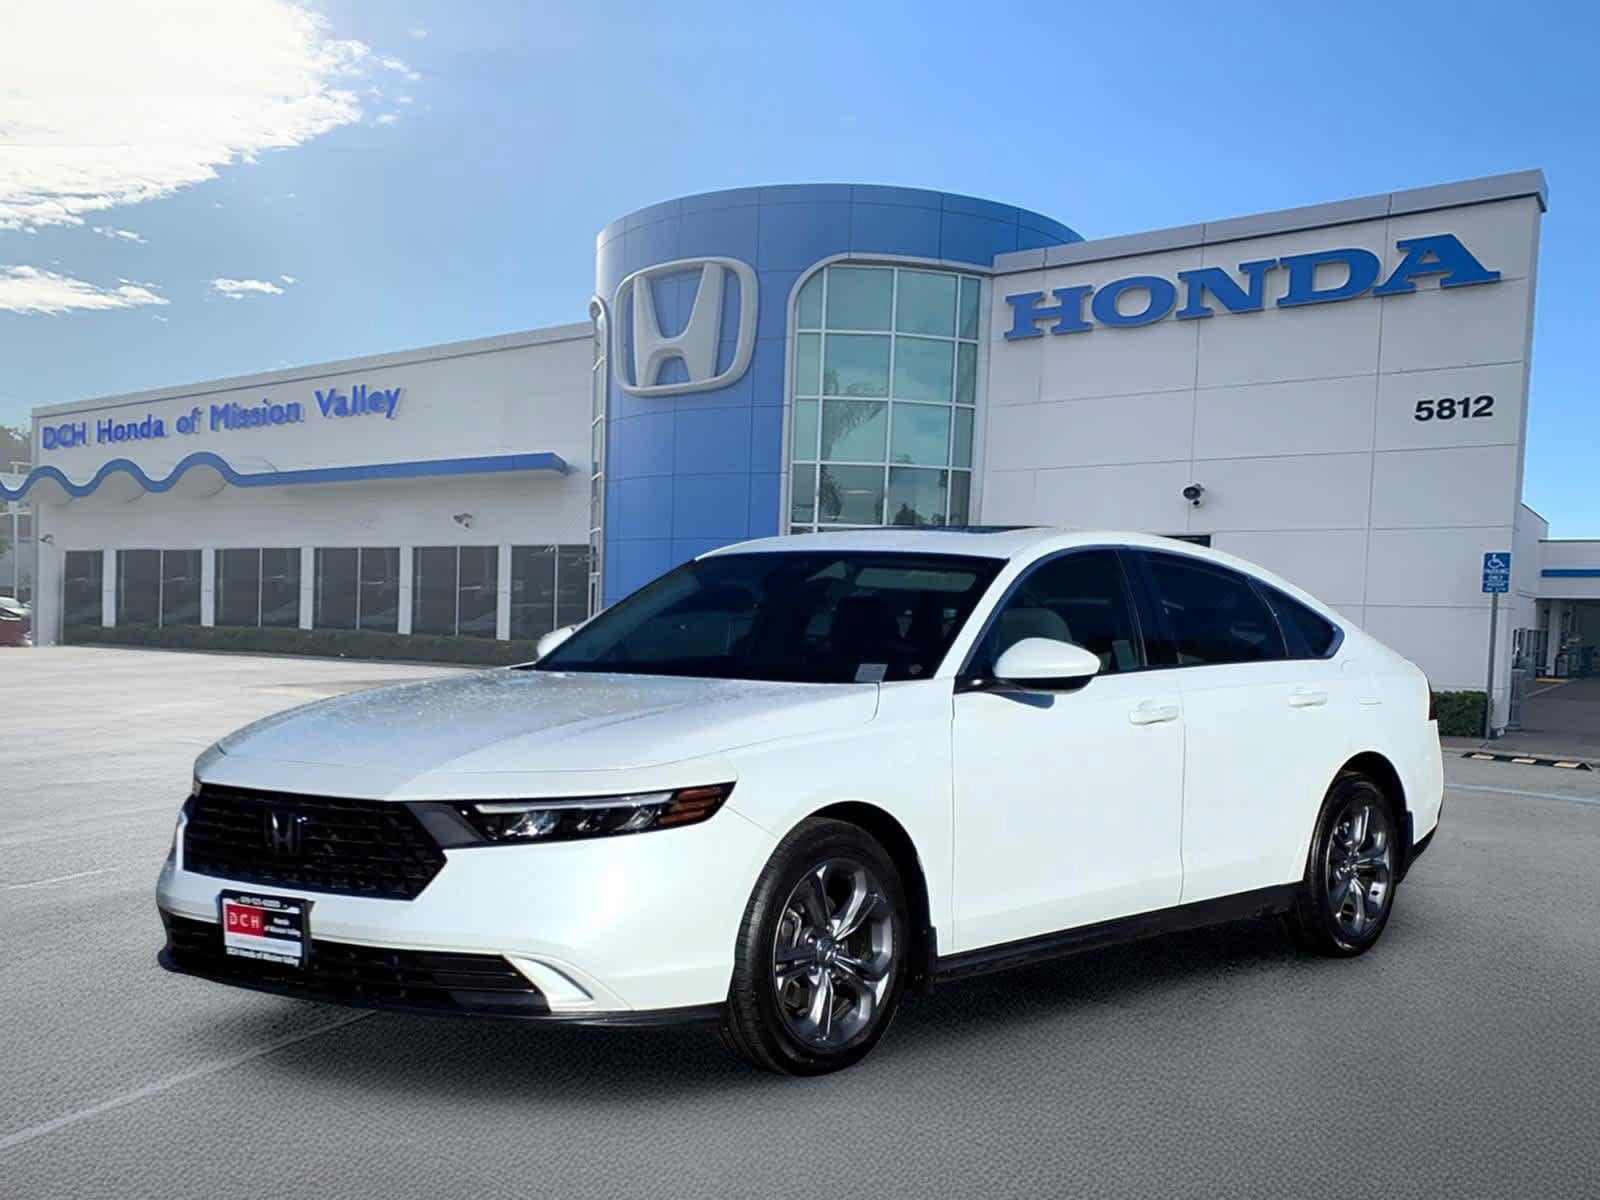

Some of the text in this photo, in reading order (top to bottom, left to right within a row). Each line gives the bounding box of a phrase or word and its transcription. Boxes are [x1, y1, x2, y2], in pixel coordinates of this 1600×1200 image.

[1004, 233, 1501, 340] HONDA
[43, 384, 401, 449] DCH Honda of Mission Valley
[1414, 395, 1495, 422] 5812
[228, 911, 260, 928] DCH
